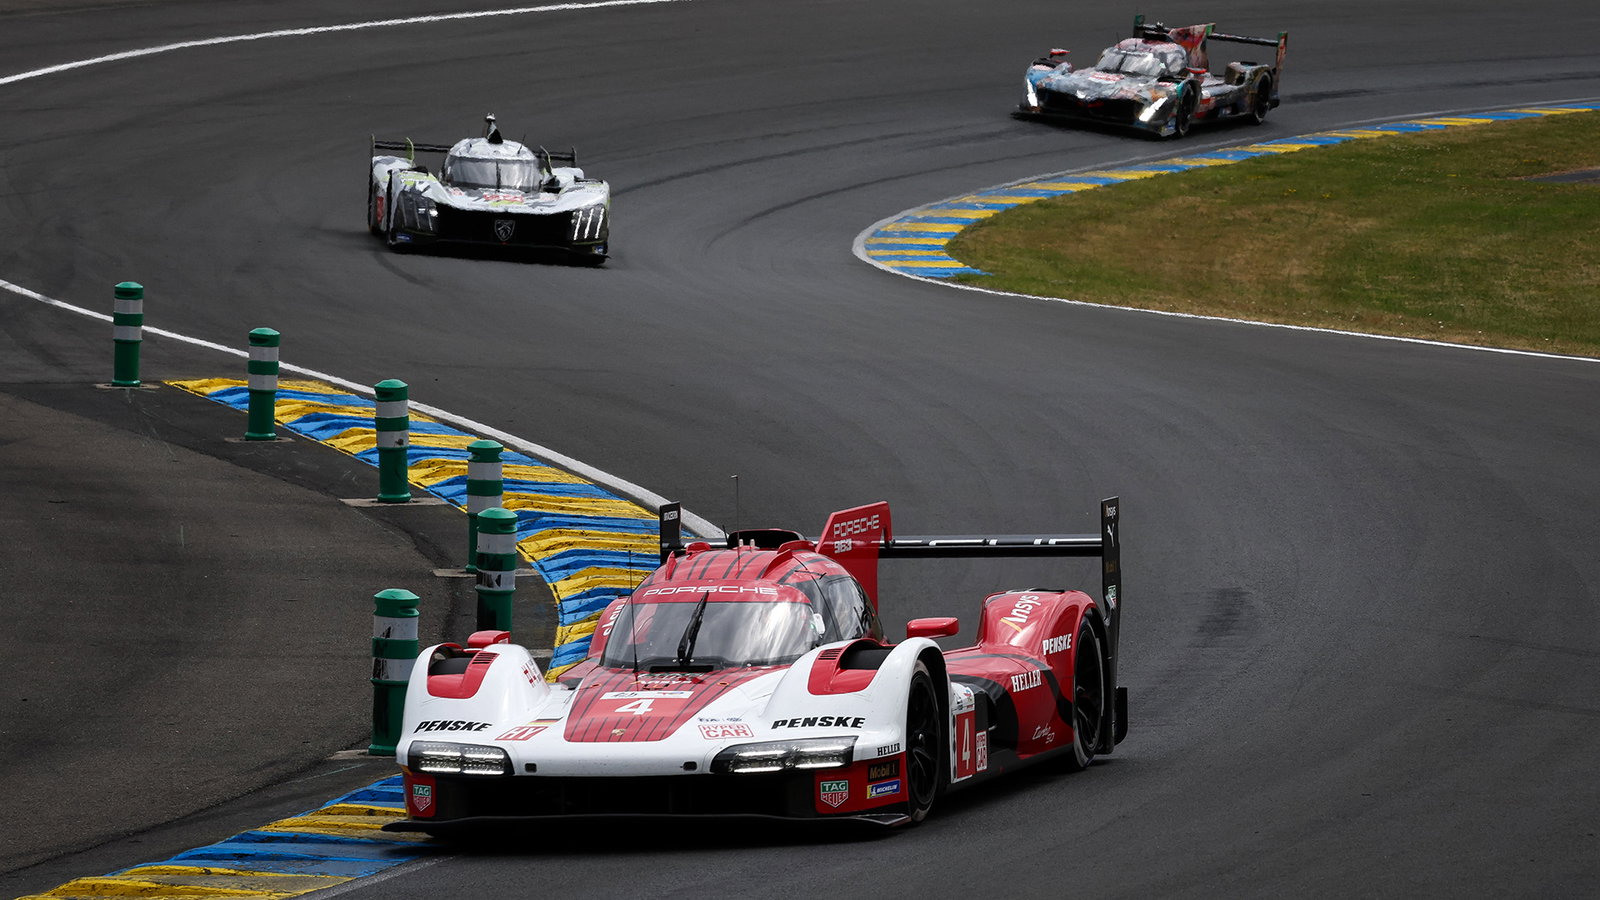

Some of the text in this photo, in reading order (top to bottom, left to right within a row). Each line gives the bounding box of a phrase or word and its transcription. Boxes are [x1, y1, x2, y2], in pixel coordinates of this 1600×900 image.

[834, 514, 879, 538] PORSCHE
[642, 585, 778, 597] PORSCHE
[1000, 595, 1041, 633] Ansys
[1042, 633, 1072, 656] PENSKE
[1011, 669, 1042, 692] HELLER
[614, 698, 655, 716] 4
[413, 720, 493, 734] PENSKE
[771, 716, 866, 730] PENSKE
[705, 729, 749, 738] CAR
[877, 742, 900, 756] HELLER
[962, 718, 971, 770] 4
[414, 786, 430, 796] TAG
[823, 782, 846, 791] TAG
[822, 792, 847, 805] HEUER
